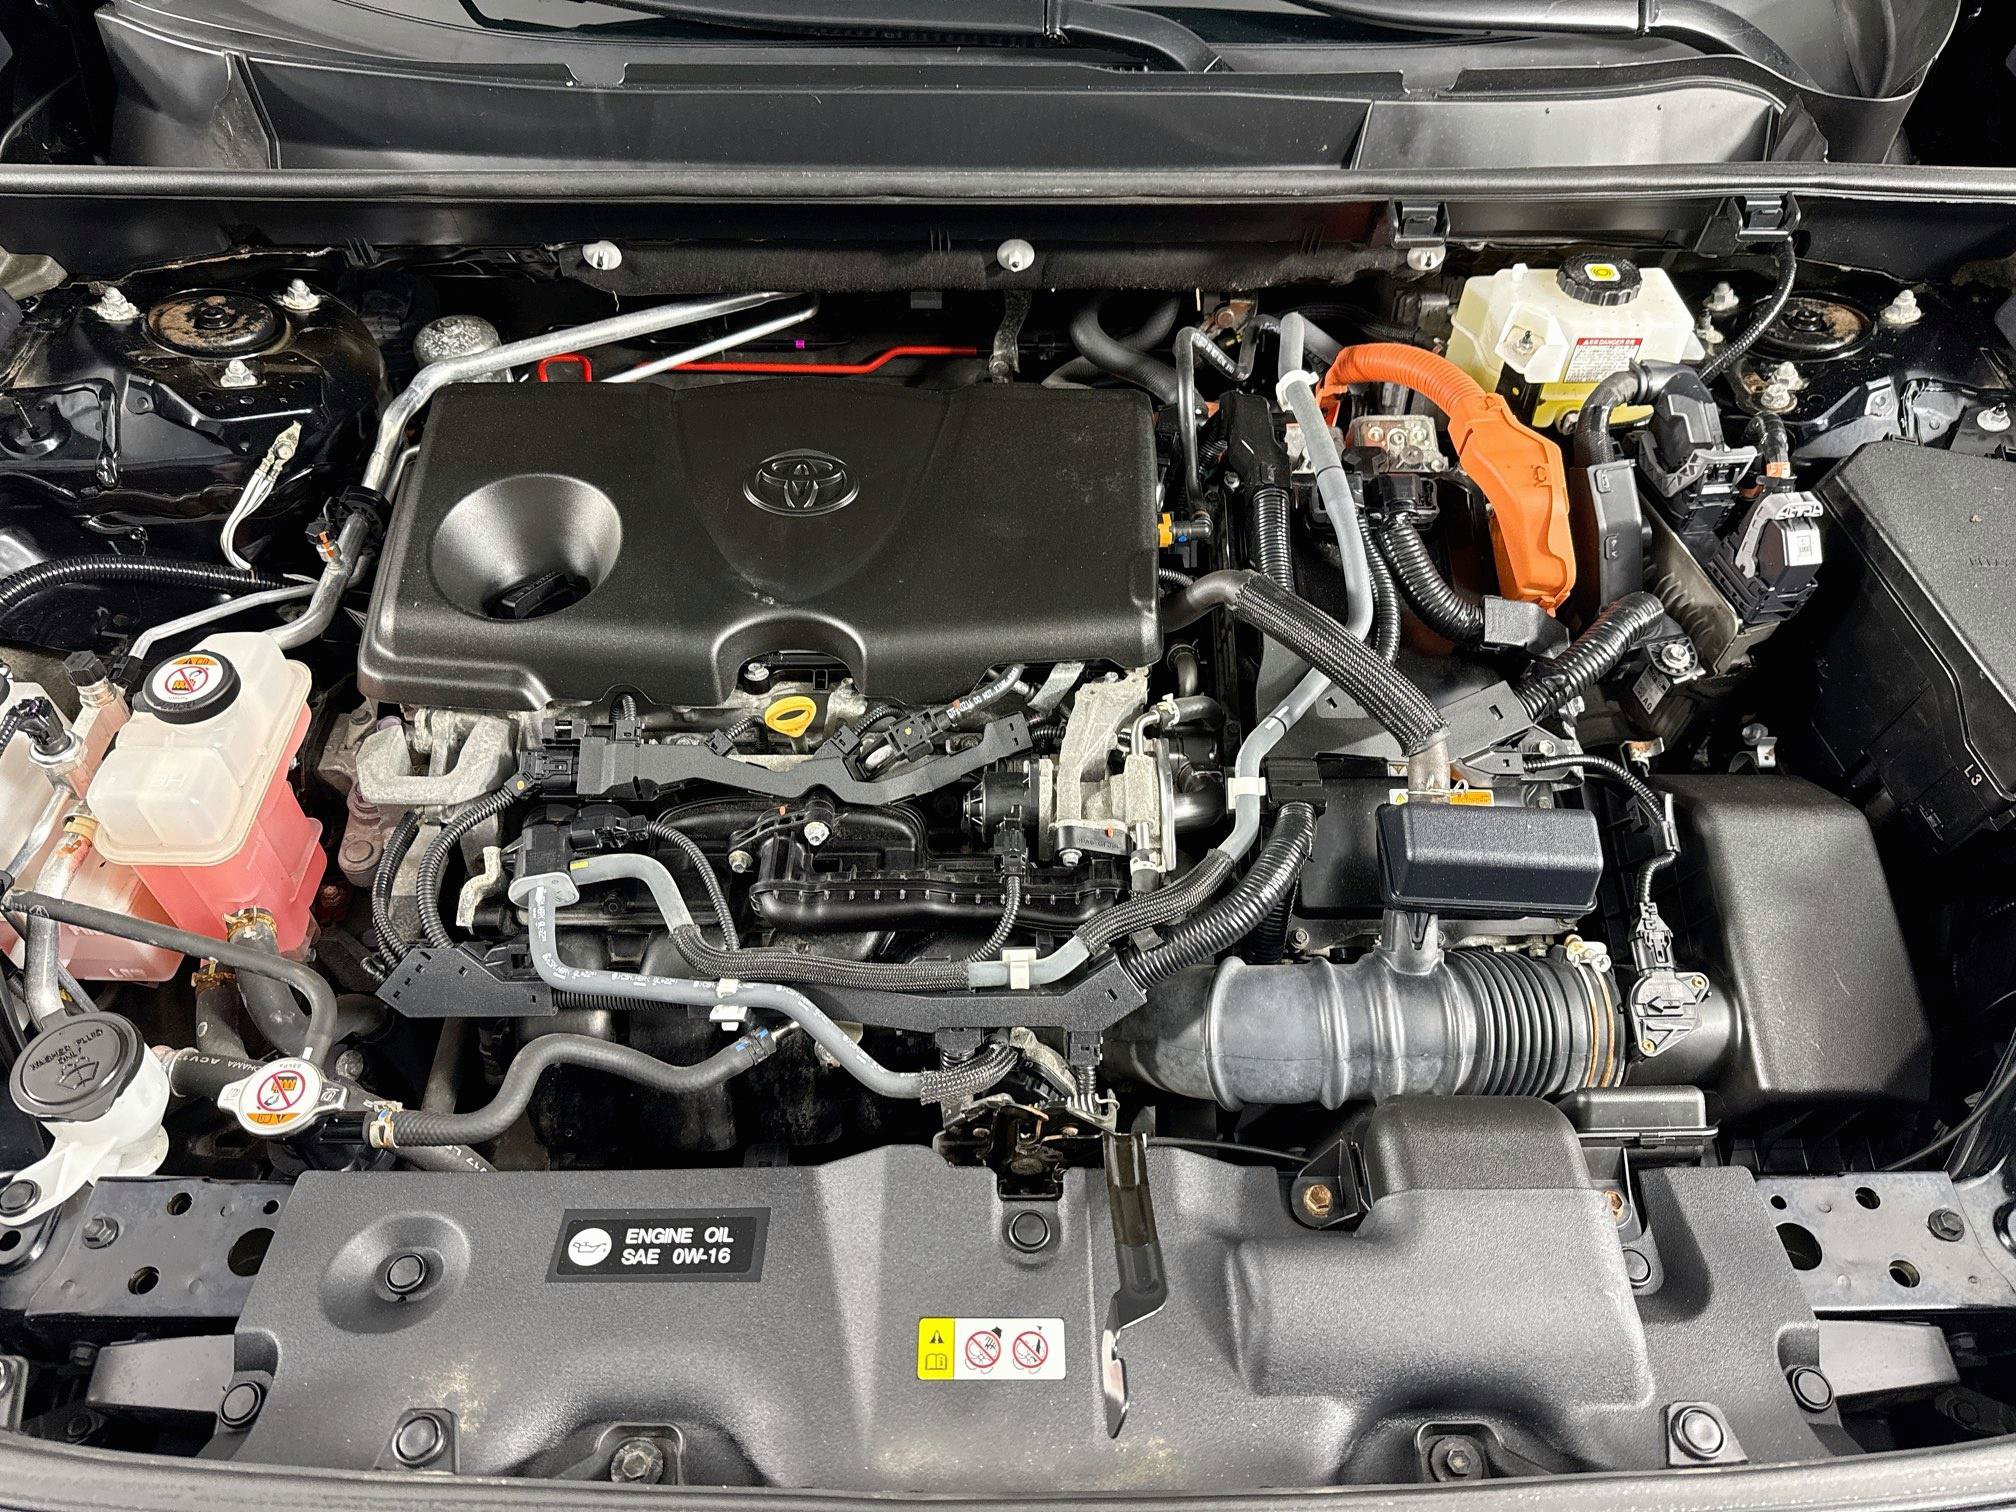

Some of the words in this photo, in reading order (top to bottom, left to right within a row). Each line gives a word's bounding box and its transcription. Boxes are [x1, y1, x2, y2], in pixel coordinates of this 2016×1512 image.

[1964, 764, 1982, 785] L3
[625, 1227, 694, 1244] ENGINE
[704, 1226, 734, 1243] OIL
[621, 1248, 660, 1265] SAE
[672, 1247, 731, 1264] 0W-16
